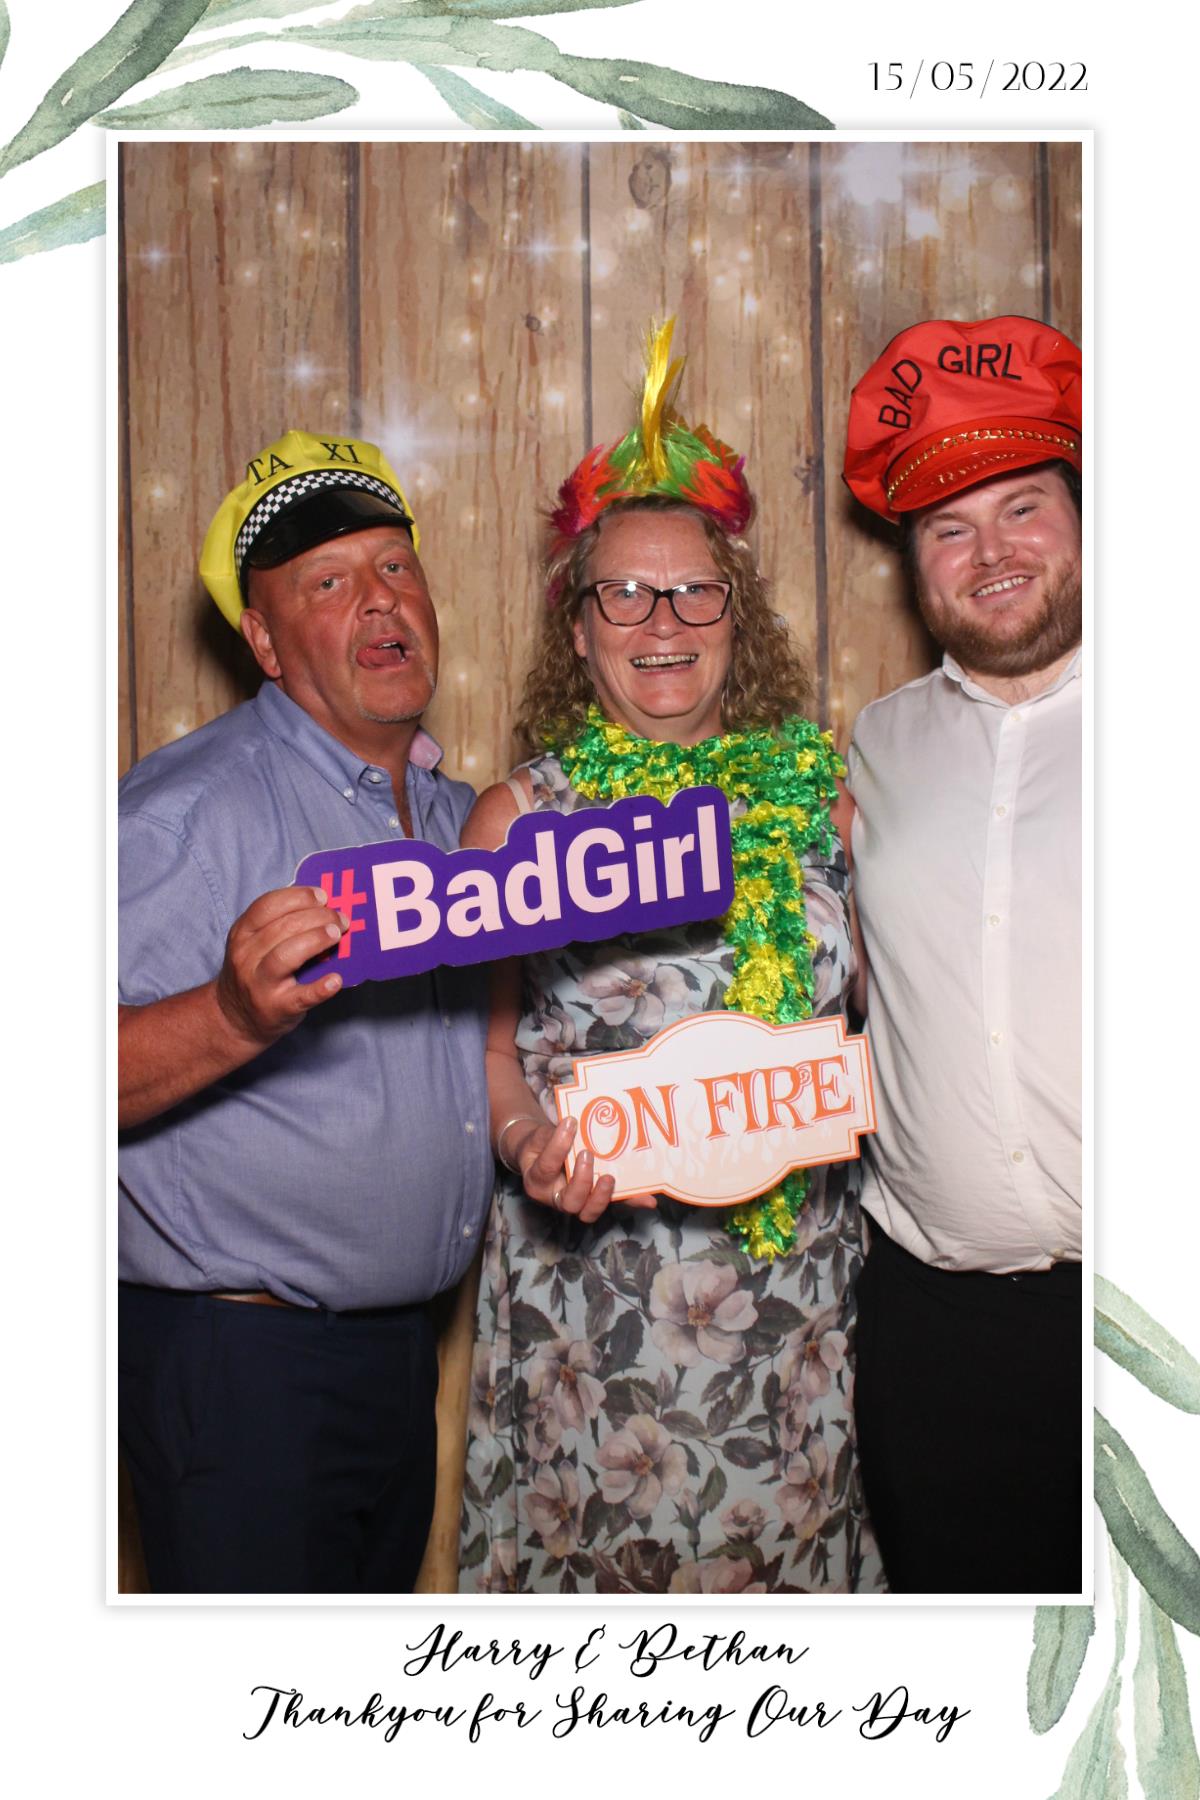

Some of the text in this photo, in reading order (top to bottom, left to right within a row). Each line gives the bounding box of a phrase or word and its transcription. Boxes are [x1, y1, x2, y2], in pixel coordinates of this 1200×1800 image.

[878, 343, 1022, 430] BAD GIRL
[320, 804, 721, 959] #BadGirl
[580, 1054, 856, 1161] ON FIRE
